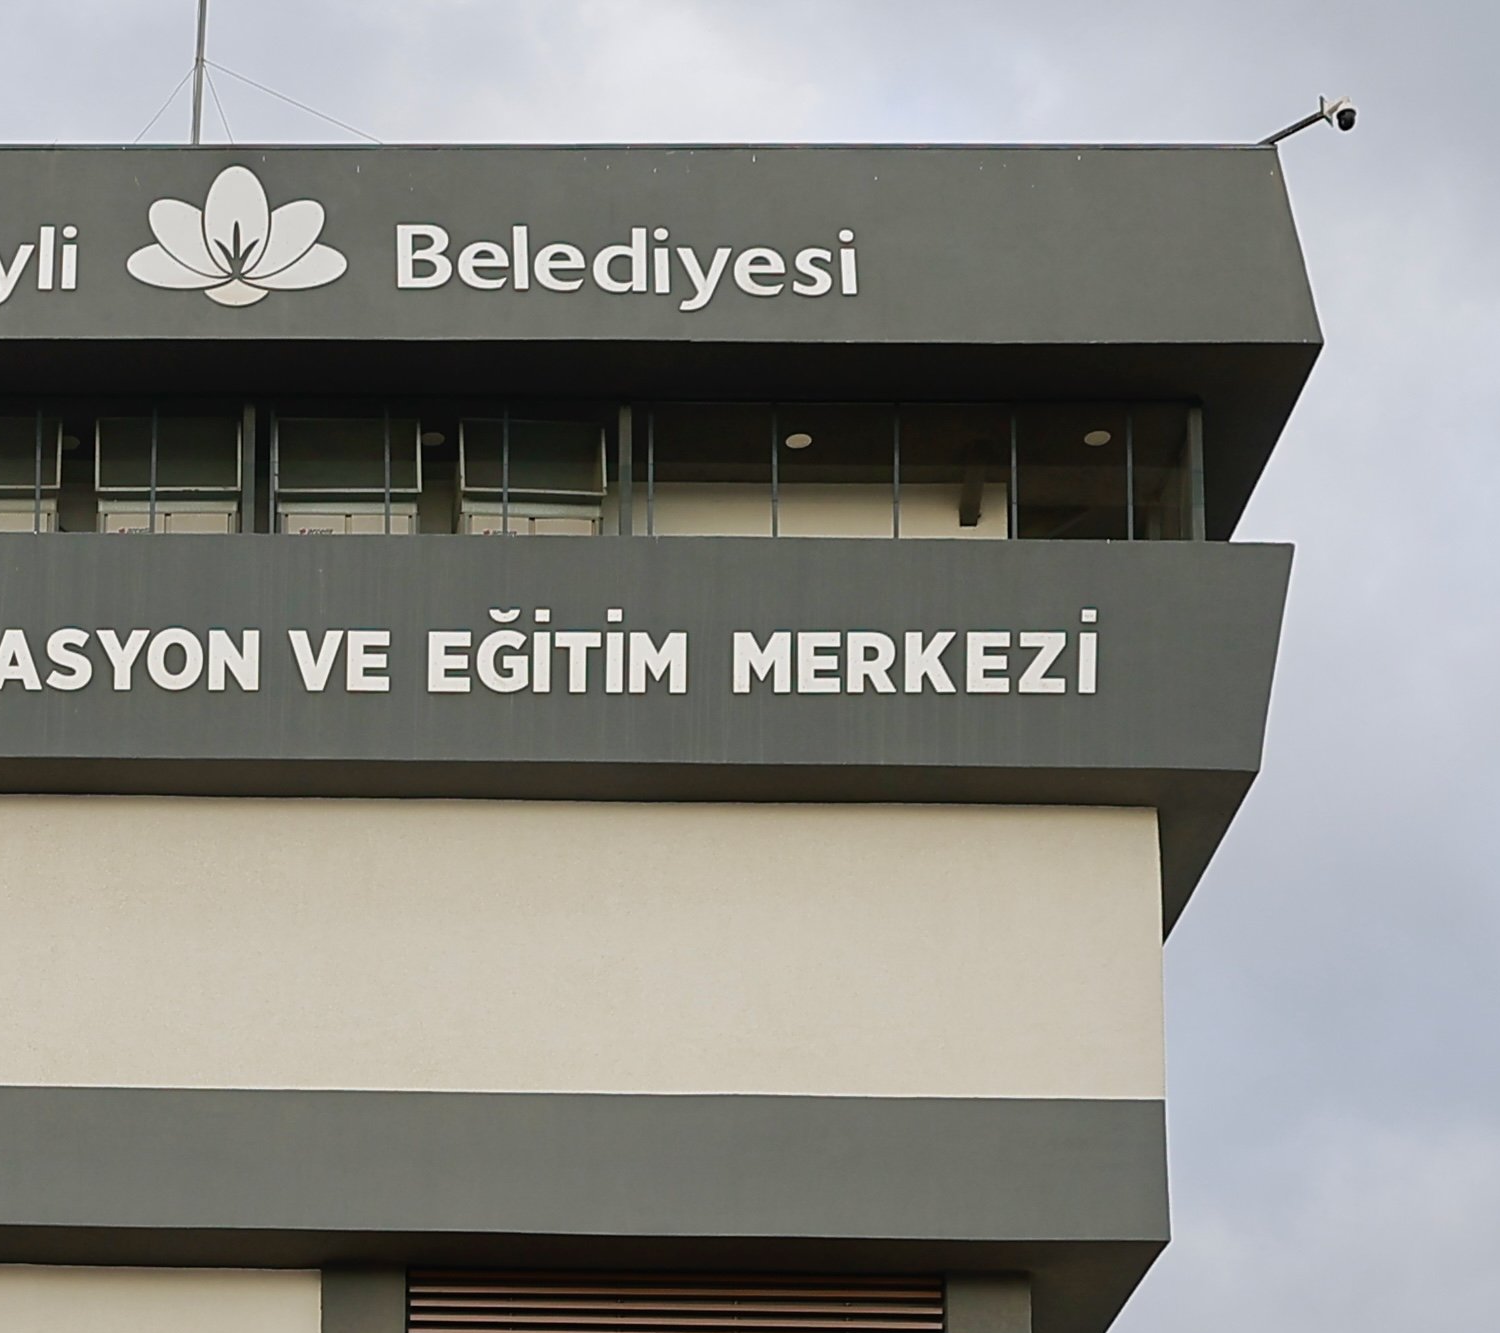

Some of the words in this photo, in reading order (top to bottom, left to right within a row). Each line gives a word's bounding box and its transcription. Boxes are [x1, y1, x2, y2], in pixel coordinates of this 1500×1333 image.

[395, 223, 859, 312] Belediyesi
[286, 629, 391, 692] VE
[426, 607, 688, 694] EĞİTİM
[732, 608, 1098, 694] MERKEZİ
